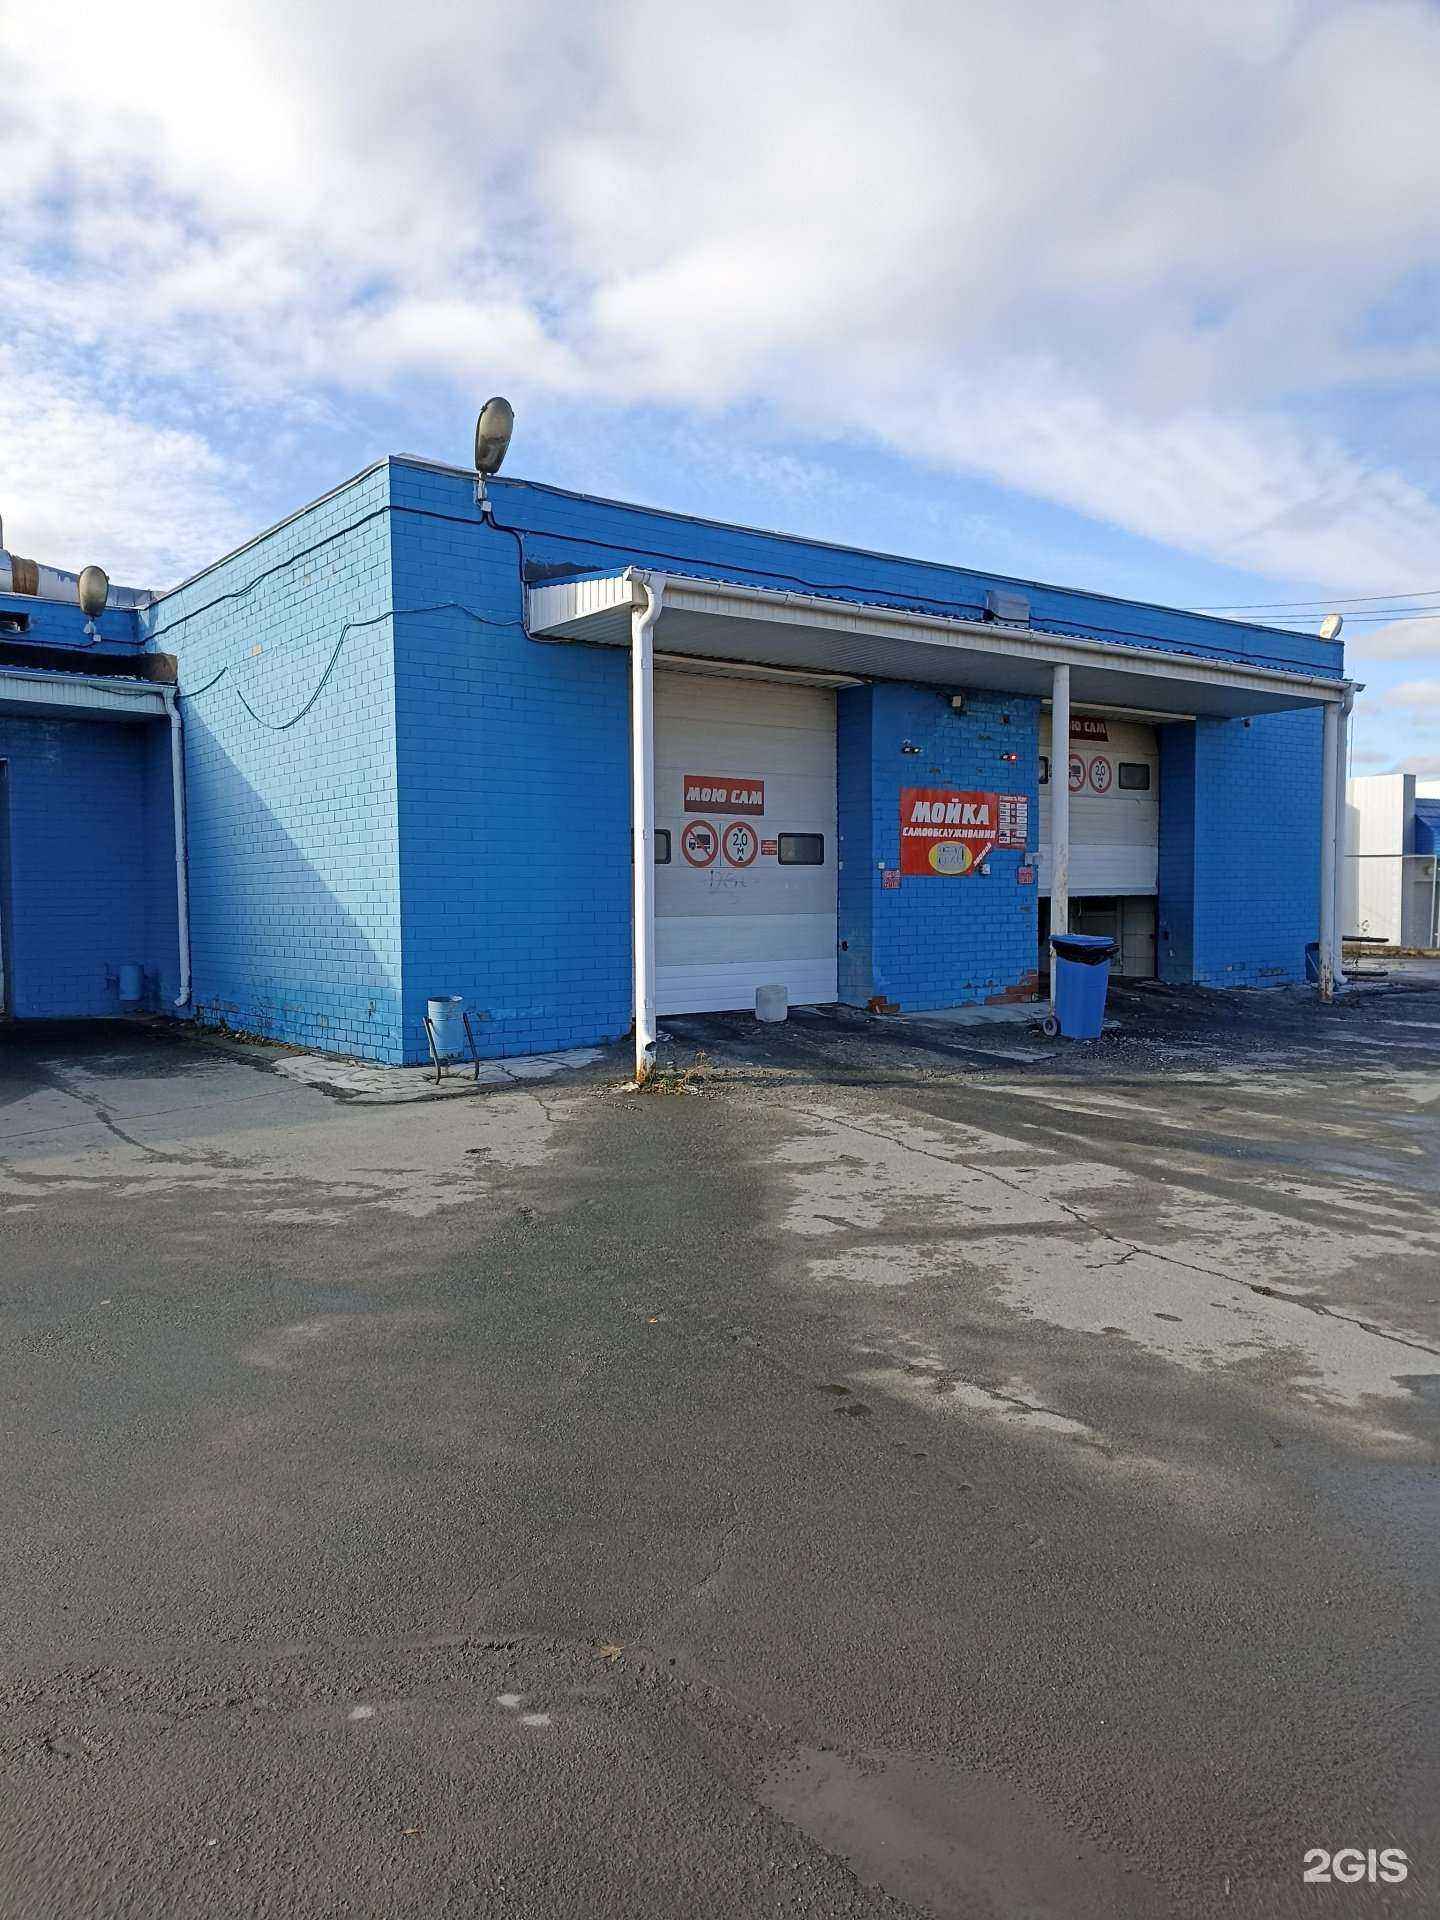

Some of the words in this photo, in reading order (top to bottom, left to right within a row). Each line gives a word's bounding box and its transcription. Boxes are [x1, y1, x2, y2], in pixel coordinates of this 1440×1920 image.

[1084, 721, 1106, 734] САМ
[686, 787, 727, 803] МОЮ
[731, 789, 763, 805] САМ
[911, 797, 990, 825] МОЙКА
[902, 826, 997, 839] САМООБСЛУЖИВАНИЯ
[732, 833, 748, 848] 2,0
